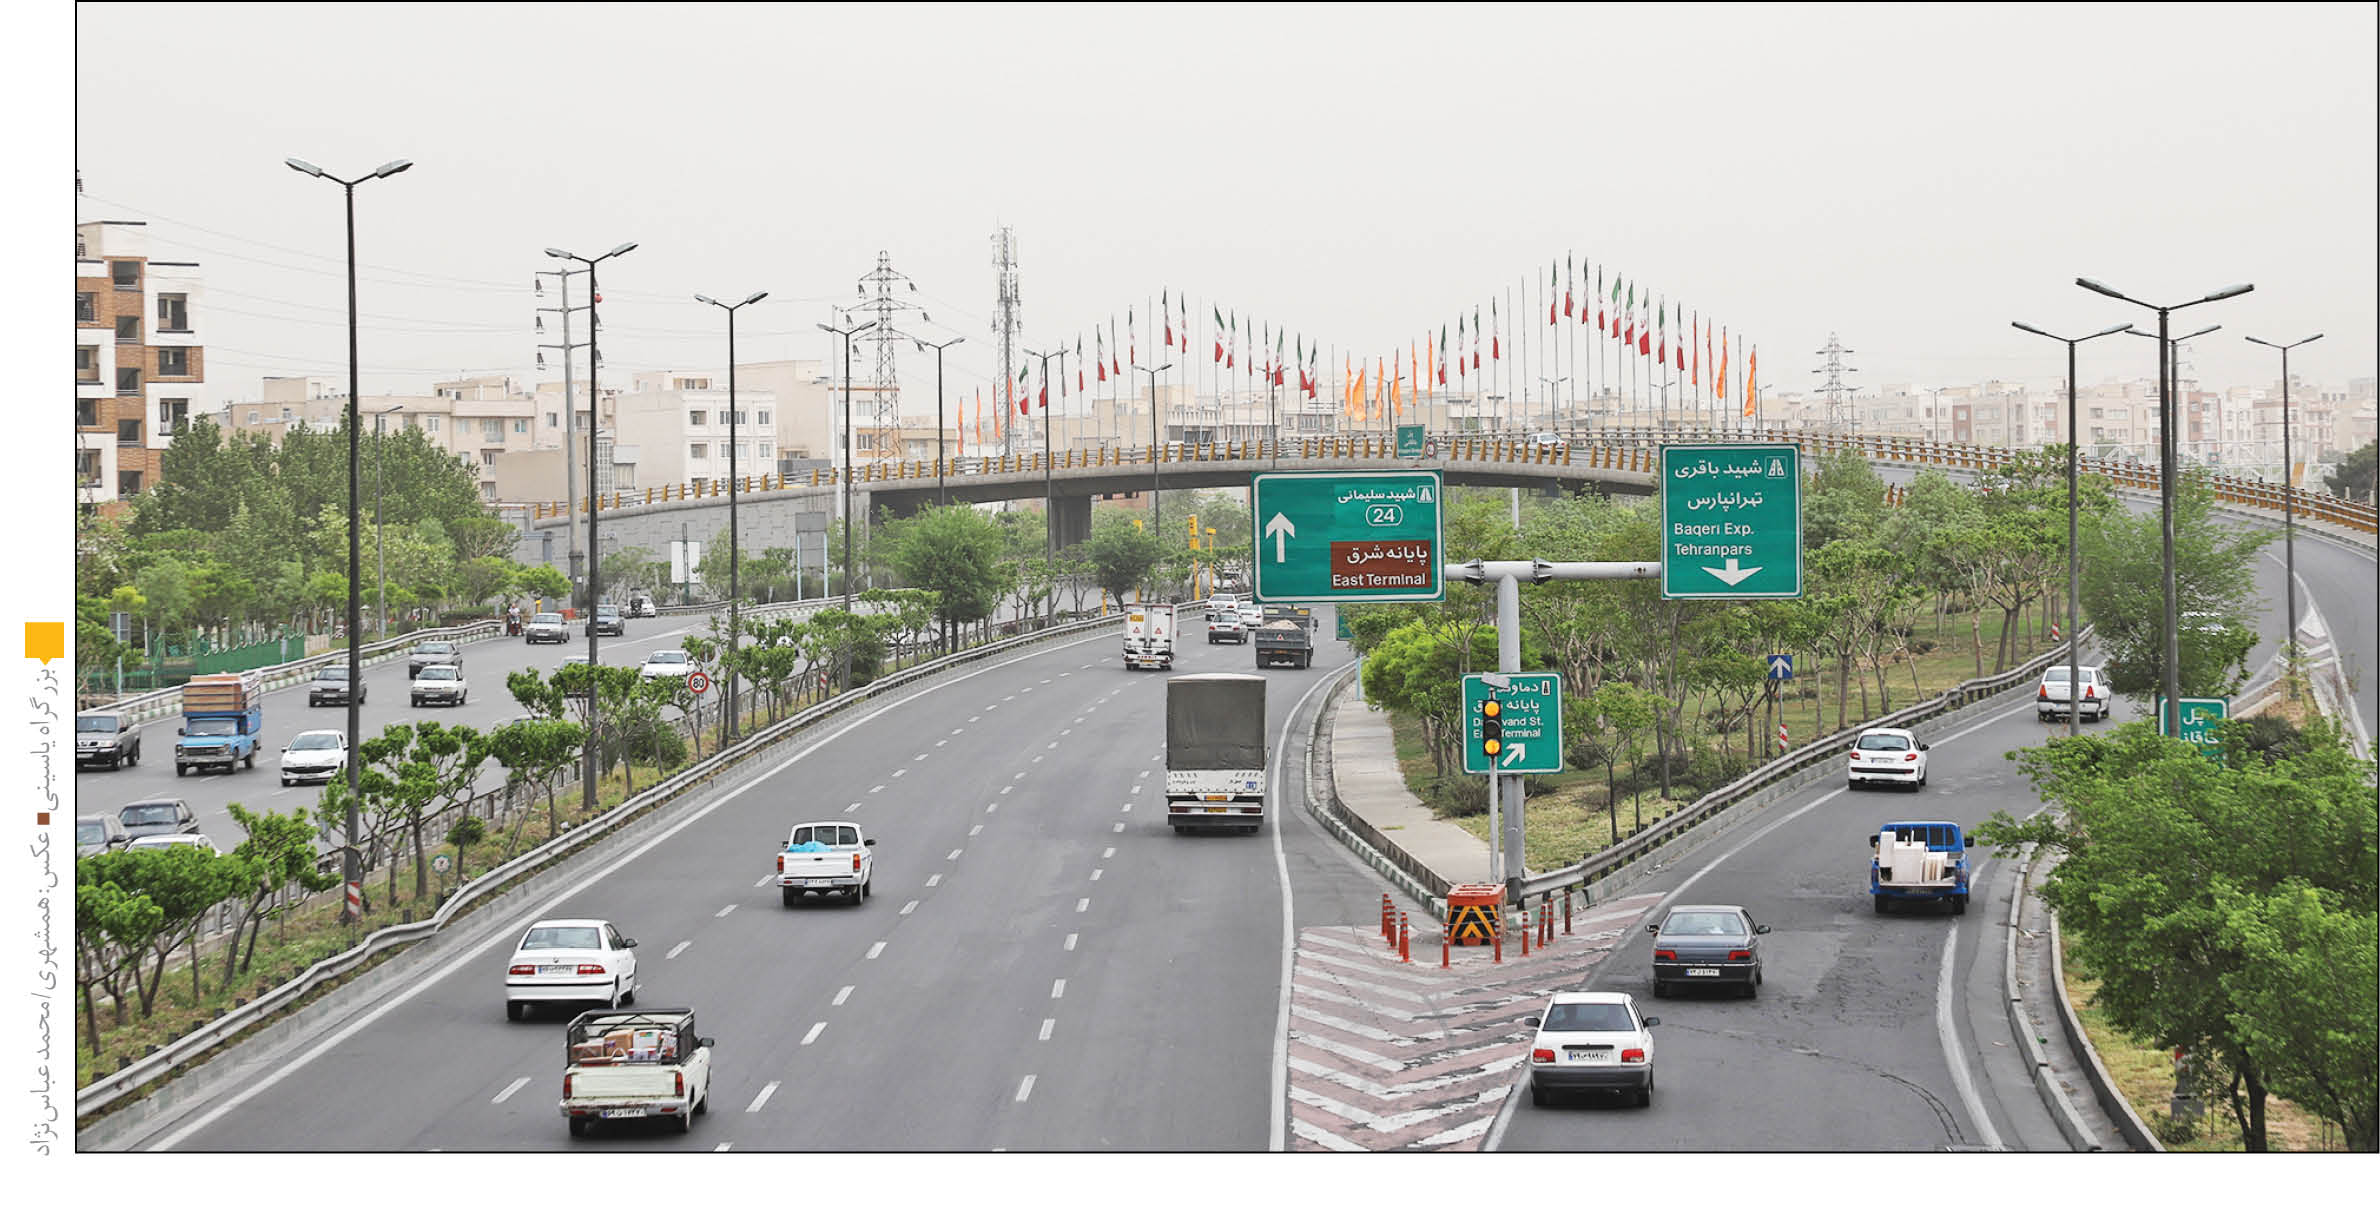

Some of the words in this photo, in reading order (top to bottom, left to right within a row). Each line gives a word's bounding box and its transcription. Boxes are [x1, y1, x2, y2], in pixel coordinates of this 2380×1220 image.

[1674, 460, 1720, 479] باقری
[1723, 460, 1763, 479] شهید
[1337, 489, 1385, 504] سلیمانی
[1387, 488, 1416, 502] شهید
[1687, 491, 1764, 512] تهرانپارس
[1373, 508, 1395, 522] 24
[1674, 522, 1720, 537] Baqeri
[1724, 522, 1755, 537] Exp.
[1346, 544, 1385, 565] شرق
[1387, 546, 1428, 566] پایانه
[1674, 543, 1753, 558] Tehranpars
[1332, 574, 1364, 587] East
[1367, 573, 1426, 586] Terminal
[1506, 699, 1540, 715] پایانه
[1473, 717, 1527, 727] Dvand
[1529, 716, 1545, 727] St.
